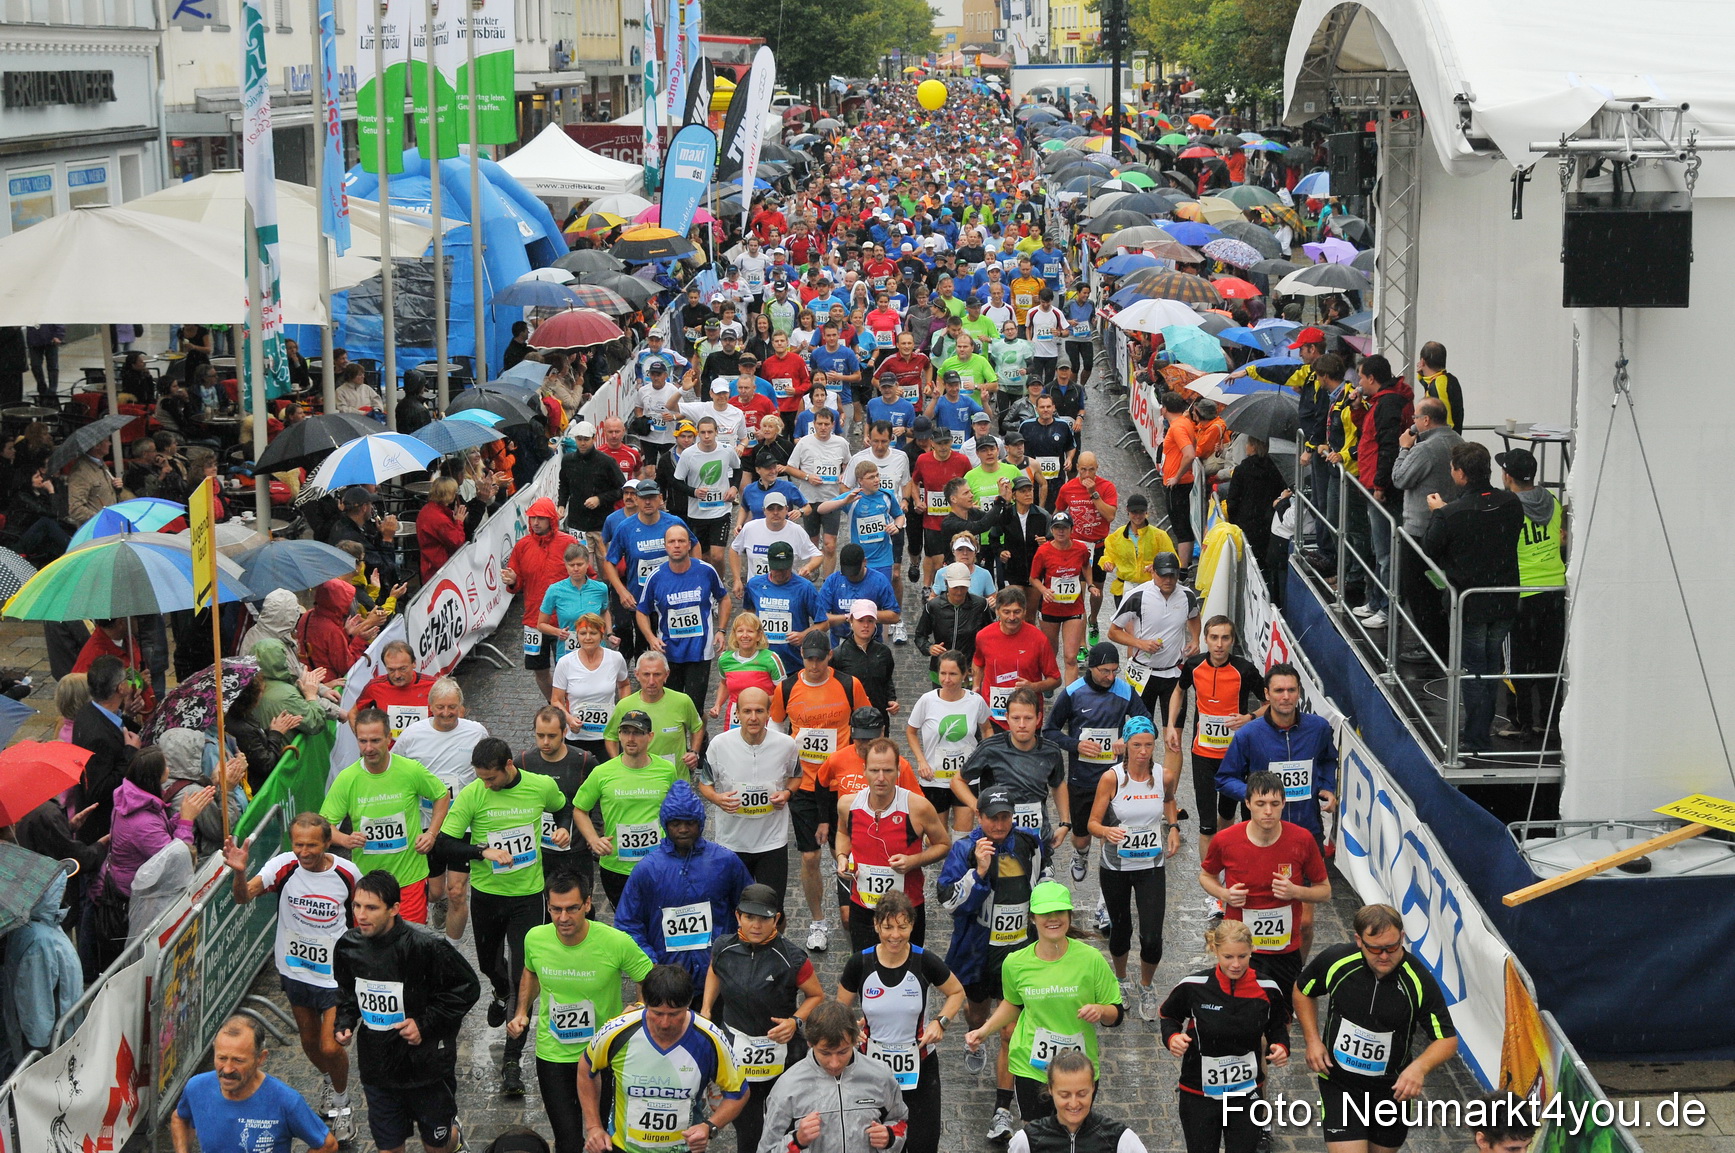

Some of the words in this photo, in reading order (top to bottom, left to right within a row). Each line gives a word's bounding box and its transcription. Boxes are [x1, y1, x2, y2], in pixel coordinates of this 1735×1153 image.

[12, 70, 68, 107] BRILLEN
[69, 69, 117, 105] WEBER
[679, 147, 706, 163] maxi
[536, 183, 606, 191] www.audibkk.de
[816, 466, 837, 476] 2218
[1040, 462, 1057, 472] 568
[859, 521, 884, 536] 2695
[667, 589, 702, 602] HUBER
[1057, 583, 1075, 594] 173
[759, 597, 790, 606] HUBER
[670, 614, 699, 628] 2168
[761, 619, 789, 632] 2018
[576, 710, 608, 724] 3293
[797, 710, 843, 723] Alexander
[1205, 723, 1230, 737] 370
[802, 737, 829, 752] 343
[801, 751, 829, 760] Alexander
[741, 792, 768, 807] 306
[364, 823, 404, 841] 3304
[621, 831, 658, 848] 3323
[1122, 832, 1158, 849] 2442
[632, 849, 650, 857] Ralph
[866, 877, 895, 894] 132
[287, 895, 332, 910] GERHART
[306, 907, 337, 917] JANIG
[666, 914, 708, 936] 3421
[994, 914, 1023, 931] 620
[1252, 919, 1286, 937] 224
[1259, 937, 1280, 945] Julian
[227, 929, 249, 974] Event!
[289, 940, 329, 964] 3203
[206, 944, 223, 977] Mehr
[865, 988, 880, 997] tkn
[359, 991, 399, 1013] 2880
[371, 1014, 385, 1024] Dirk
[1339, 1033, 1386, 1061] 3156
[742, 1047, 775, 1065] 325
[1345, 1057, 1372, 1070] Roland
[744, 1067, 770, 1076] Monika
[1207, 1063, 1253, 1086] 3125
[631, 1075, 671, 1085] TEAM
[628, 1085, 692, 1100] BOCK
[638, 1111, 678, 1131] 450
[642, 1132, 670, 1143] Jürgen
